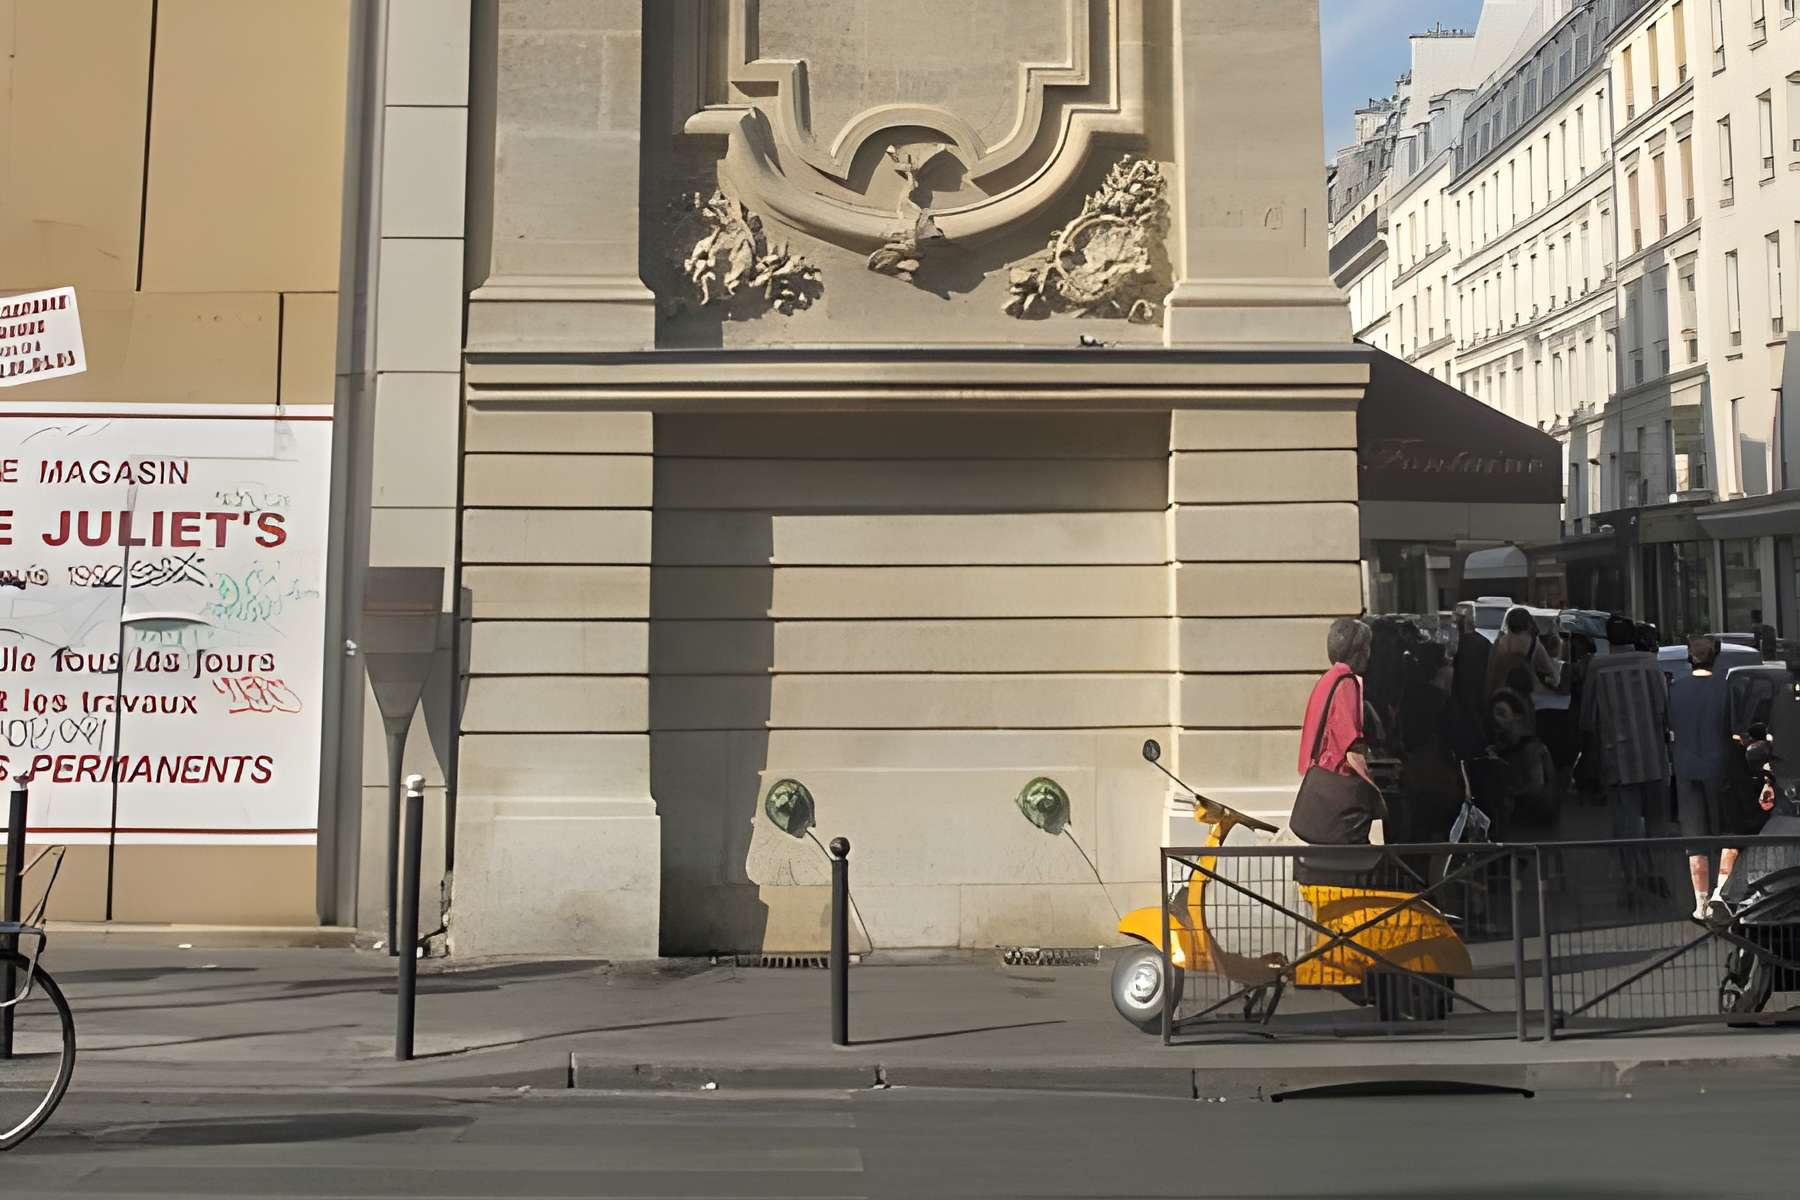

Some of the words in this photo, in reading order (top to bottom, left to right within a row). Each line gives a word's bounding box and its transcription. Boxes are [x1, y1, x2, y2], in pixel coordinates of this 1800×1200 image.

[40, 460, 189, 484] MAGASIN
[42, 511, 287, 548] JULIET'S
[82, 691, 198, 714] travaux
[28, 754, 274, 784] PERMANENTS
